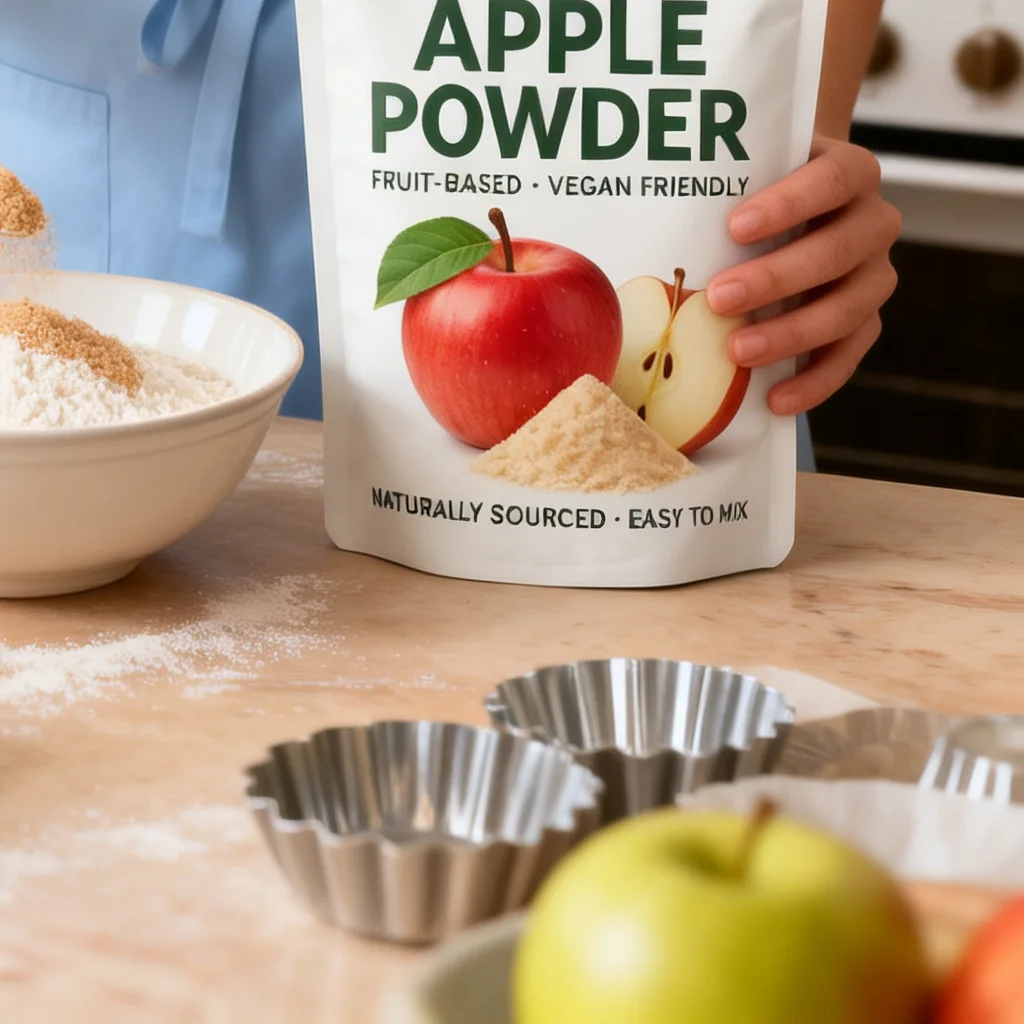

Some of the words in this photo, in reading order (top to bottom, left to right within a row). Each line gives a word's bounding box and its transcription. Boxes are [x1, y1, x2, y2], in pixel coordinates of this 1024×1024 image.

[371, 81, 751, 162] POWDER
[371, 169, 522, 195] FRUIT-BASED
[547, 175, 632, 197] VEGAN
[641, 176, 750, 198] FRIENDLY
[371, 487, 484, 524] NATURALLY
[489, 503, 607, 529] SOURCED
[628, 508, 684, 530] EASY
[688, 505, 715, 527] TO
